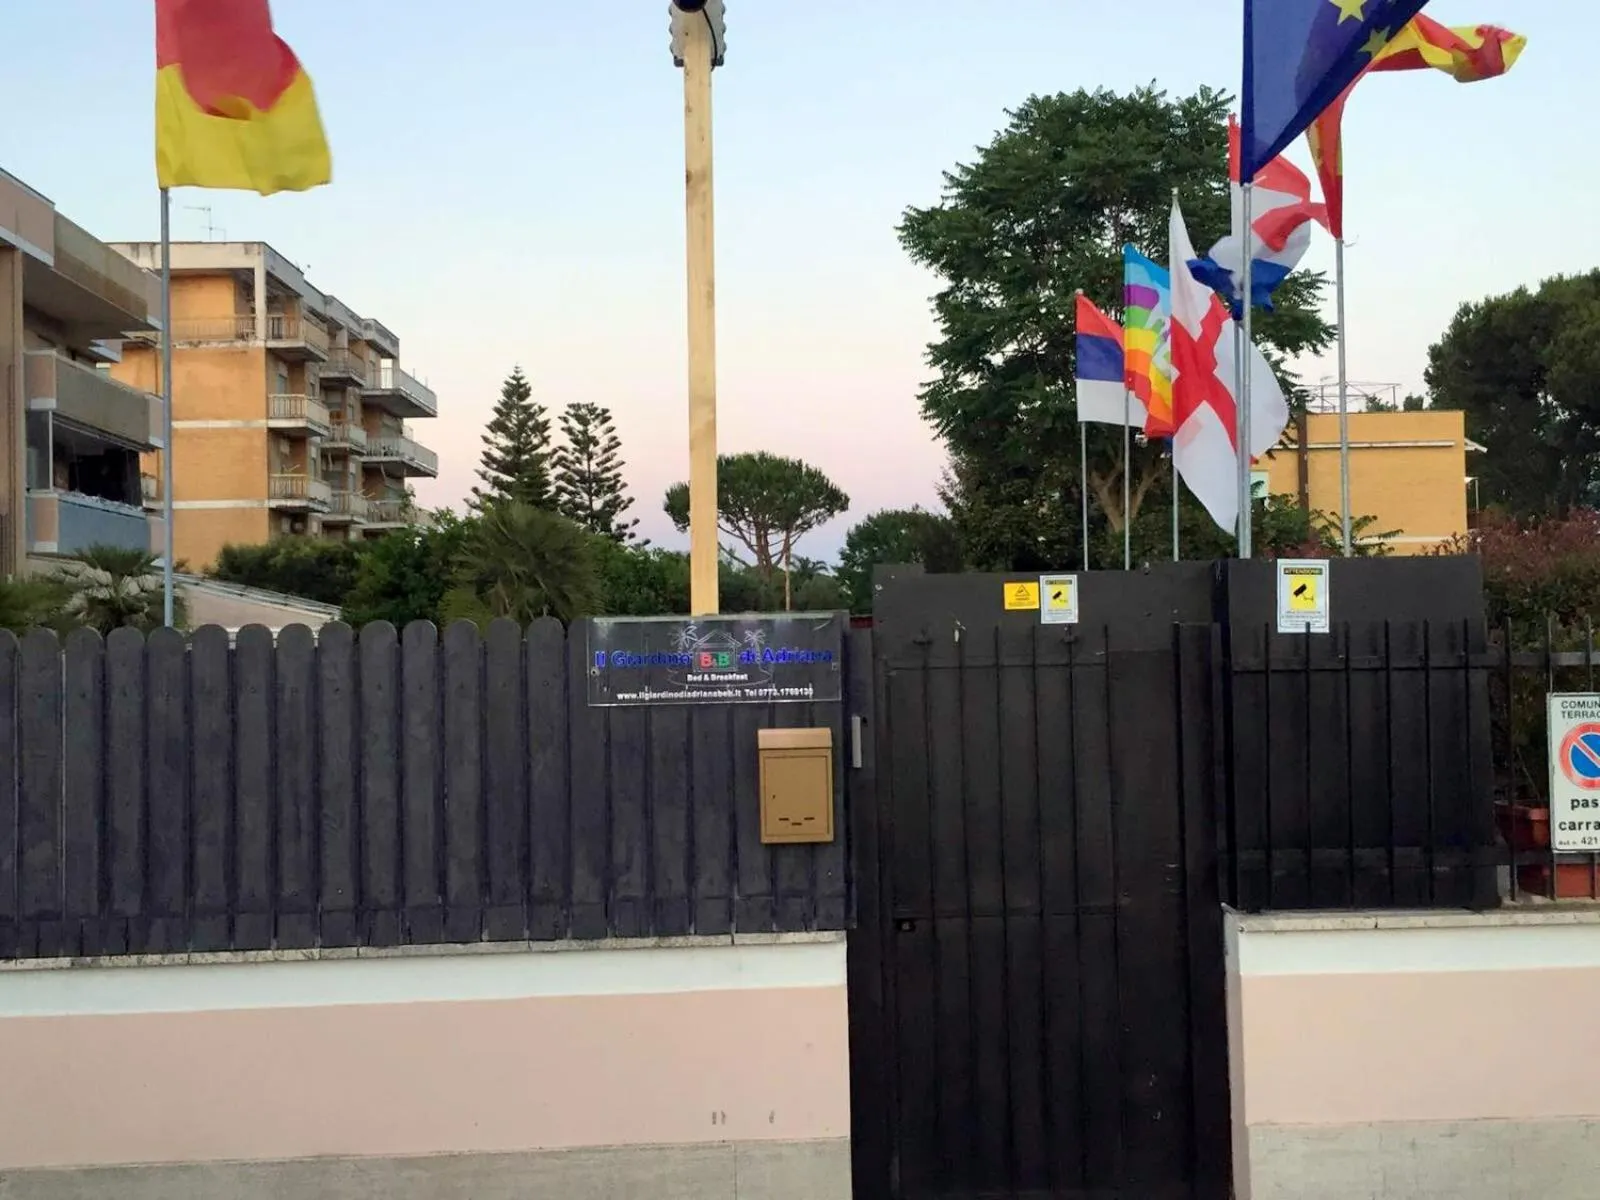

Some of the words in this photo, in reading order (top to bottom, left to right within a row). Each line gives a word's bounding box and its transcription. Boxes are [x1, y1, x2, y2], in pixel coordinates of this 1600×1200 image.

[611, 649, 691, 667] Giardino
[762, 645, 833, 664] Adriana
[687, 674, 703, 682] Bed
[711, 672, 748, 682] Breakfast
[744, 688, 757, 697] Tel
[1571, 798, 1599, 811] pas
